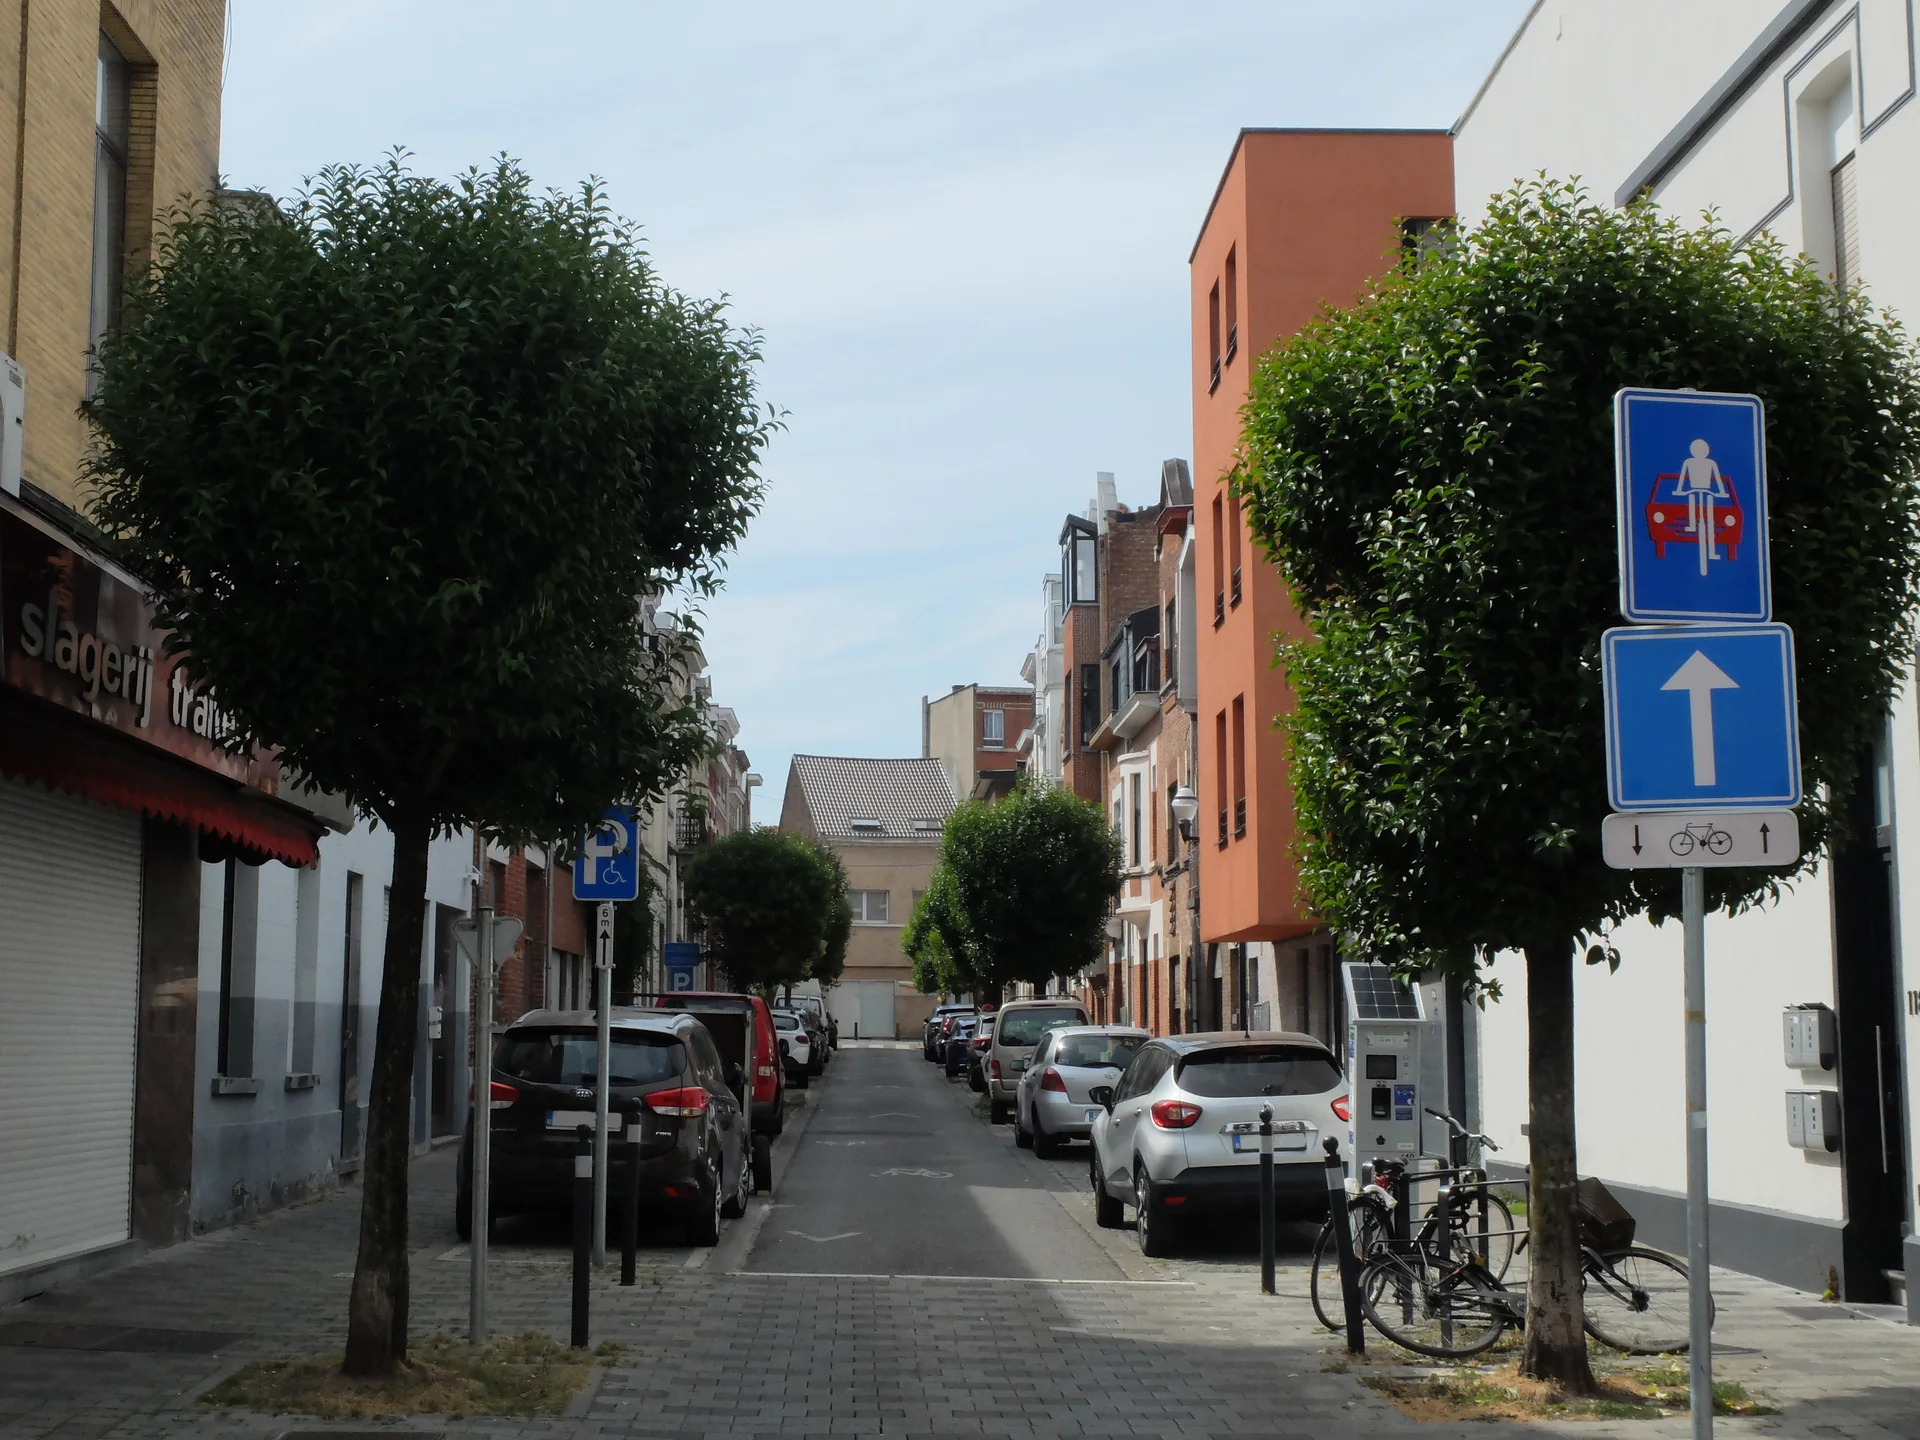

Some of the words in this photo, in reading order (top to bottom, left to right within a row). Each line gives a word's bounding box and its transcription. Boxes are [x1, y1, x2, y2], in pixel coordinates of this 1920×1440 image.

[20, 587, 154, 729] slagerij
[583, 819, 629, 885] P
[602, 908, 609, 917] 6
[601, 919, 609, 927] m
[673, 972, 691, 991] P
